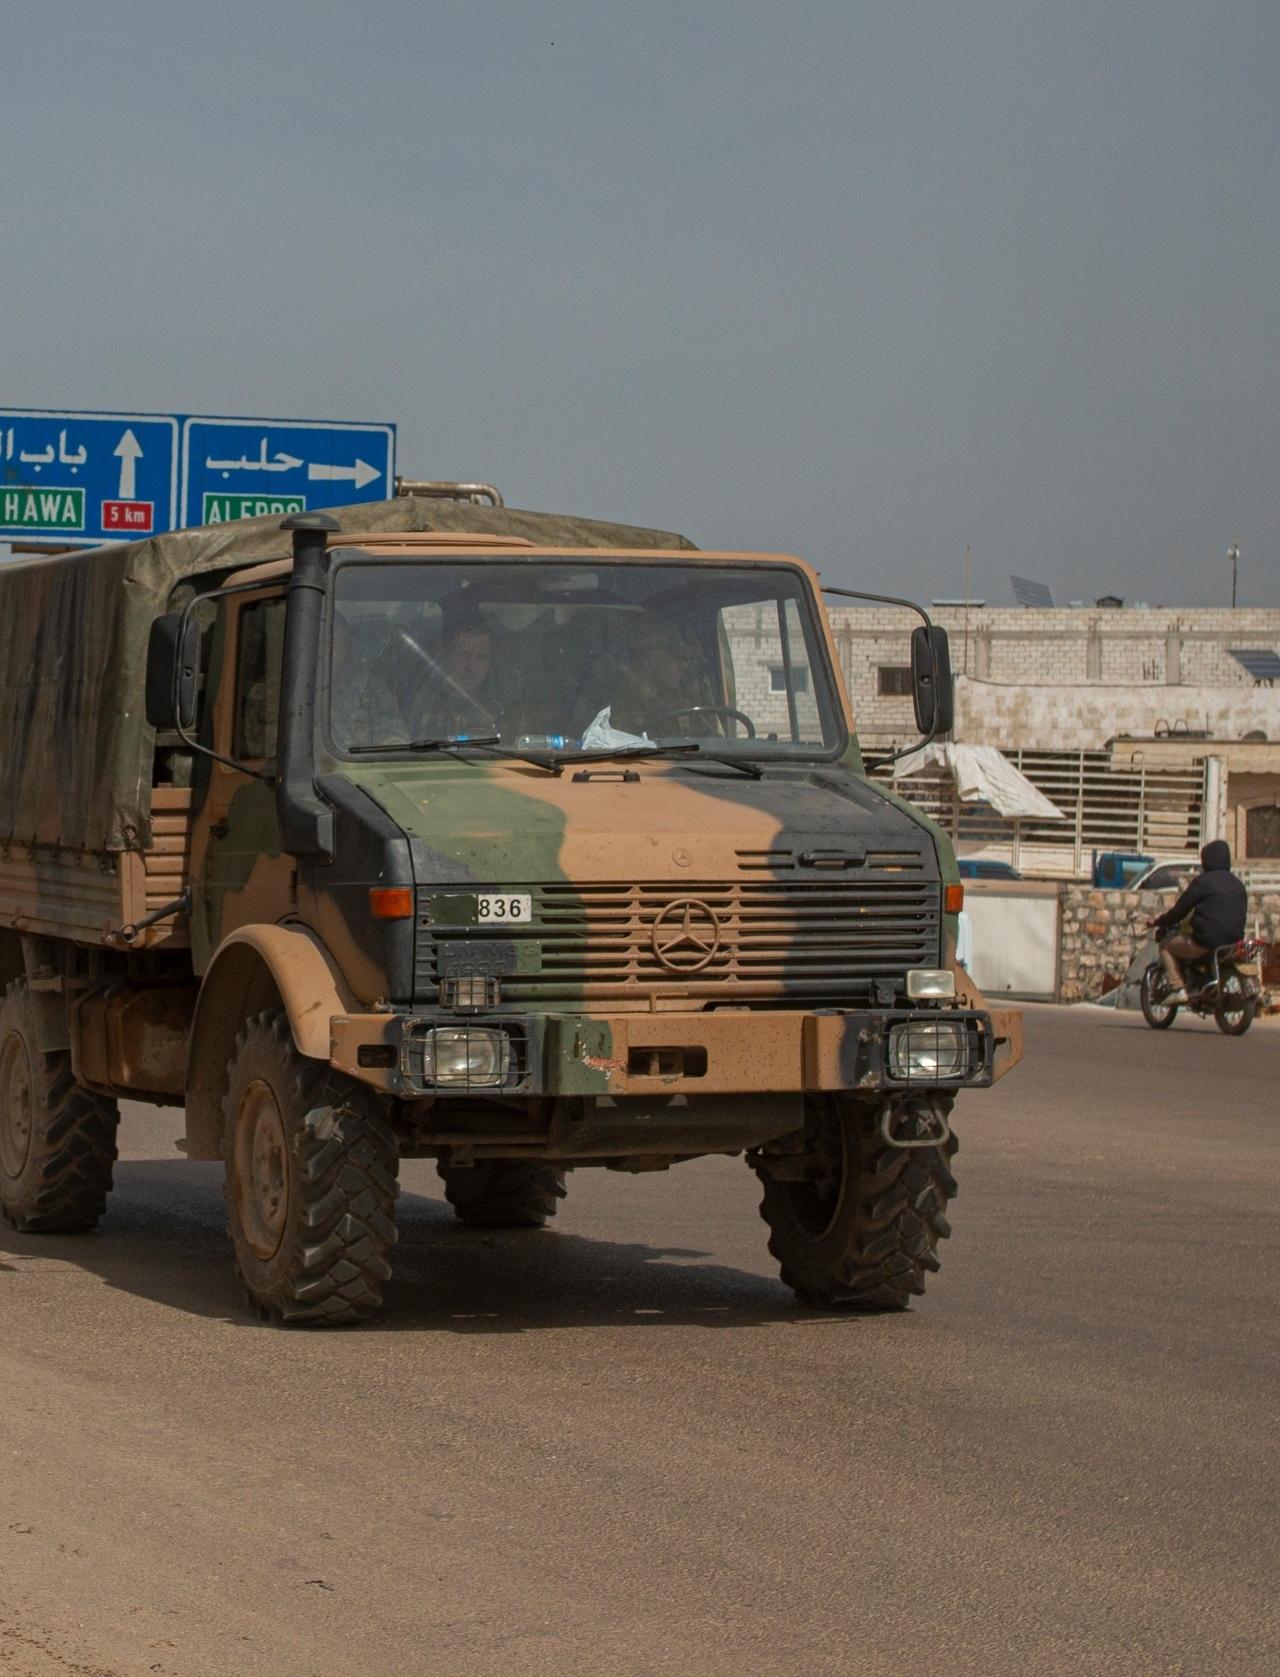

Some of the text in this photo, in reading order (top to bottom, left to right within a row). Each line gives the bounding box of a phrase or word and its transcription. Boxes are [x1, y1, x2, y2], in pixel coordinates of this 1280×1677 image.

[20, 428, 87, 474] باب
[206, 437, 304, 479] حلب
[111, 507, 145, 523] 5 km
[479, 899, 521, 918] 836
